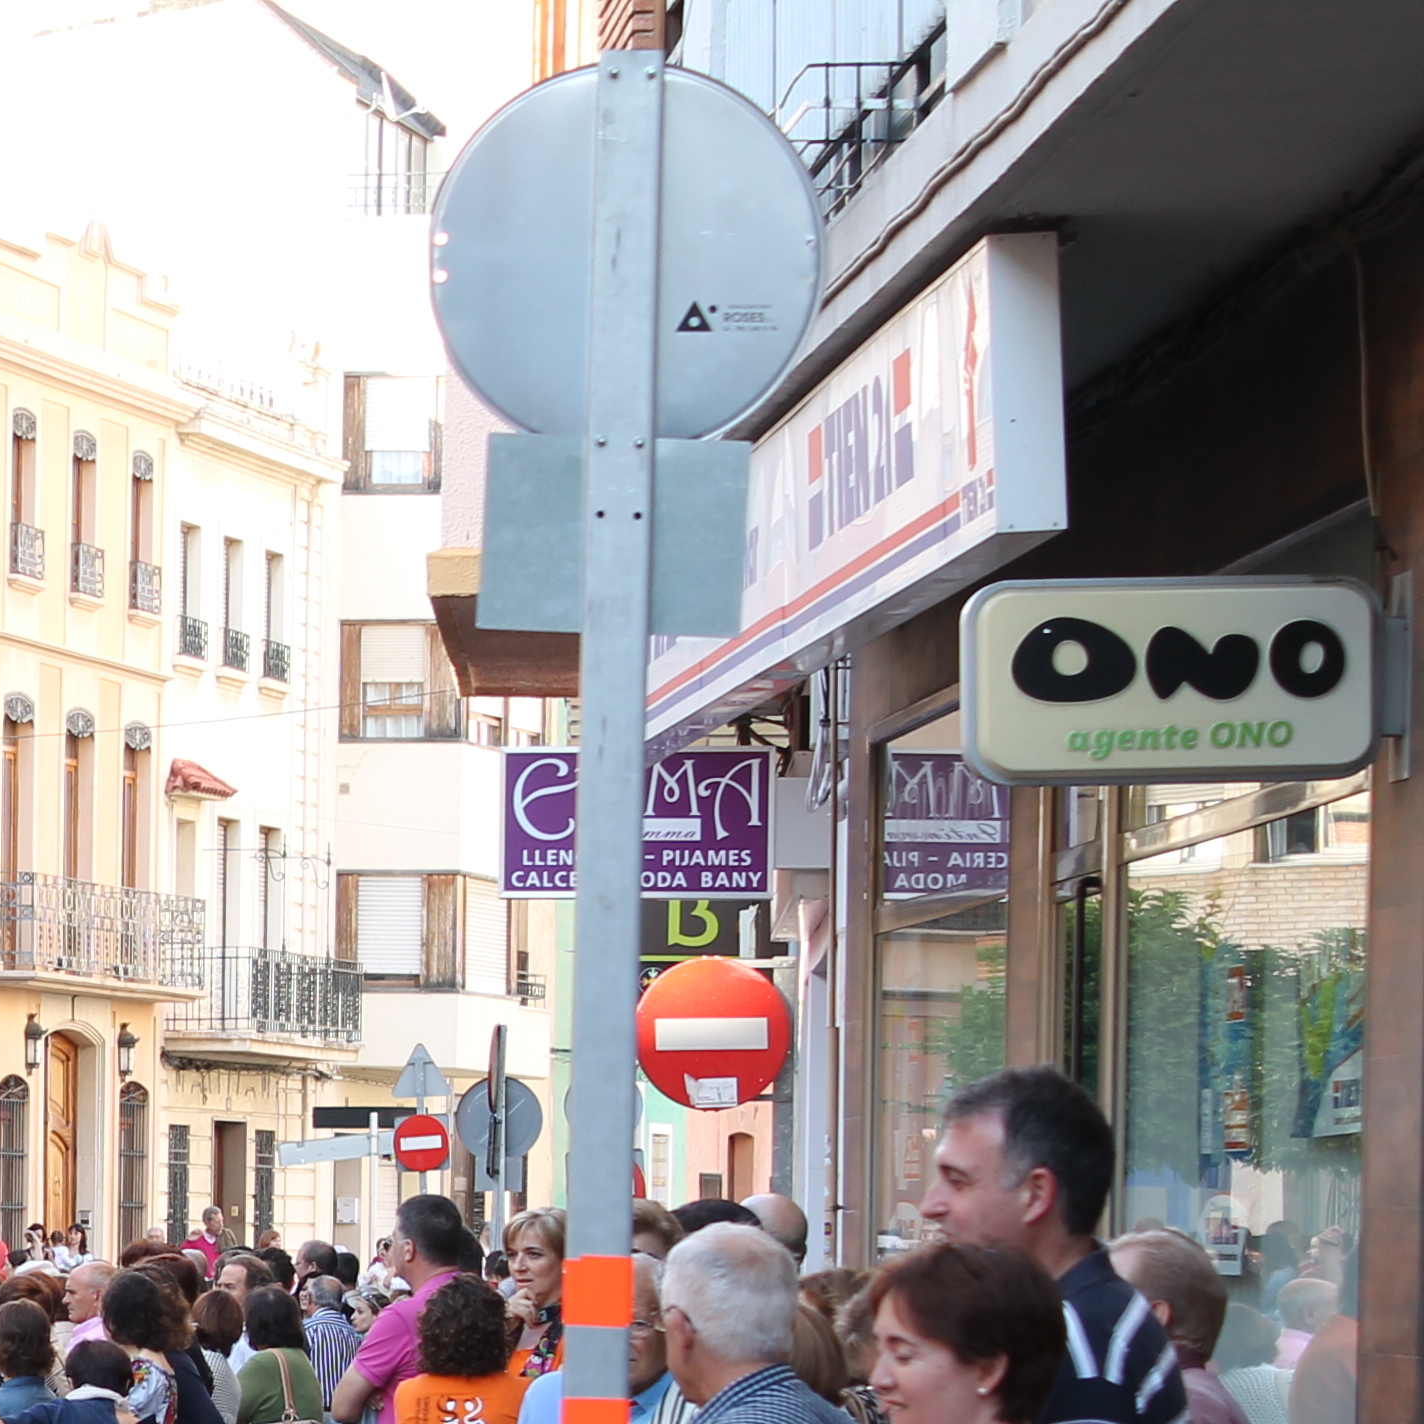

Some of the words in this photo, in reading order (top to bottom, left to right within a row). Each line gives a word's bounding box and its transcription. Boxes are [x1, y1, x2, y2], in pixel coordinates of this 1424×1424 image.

[1011, 616, 1345, 703] ONO
[1064, 724, 1199, 761] agente
[1208, 720, 1294, 748] ONO
[522, 849, 578, 866] LLEN
[662, 849, 752, 867] PIJAMES
[640, 871, 688, 888] ODA
[701, 871, 763, 888] BANY
